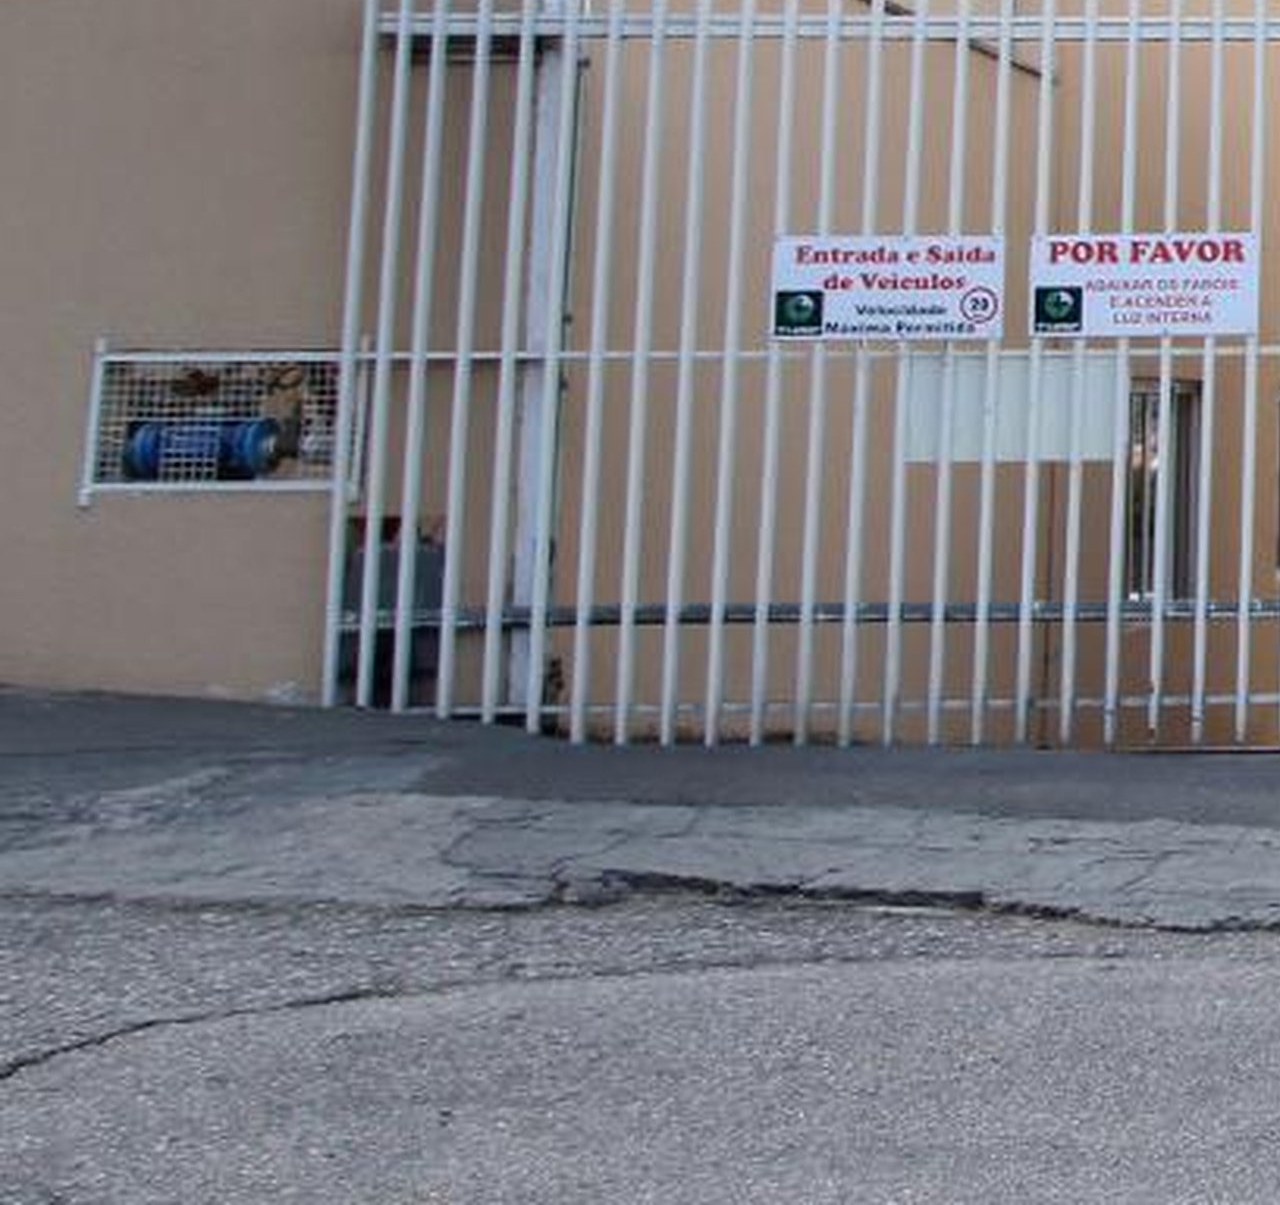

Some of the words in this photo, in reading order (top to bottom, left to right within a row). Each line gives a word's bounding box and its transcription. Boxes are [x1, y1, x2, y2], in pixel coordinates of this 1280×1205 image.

[796, 246, 899, 264] Entrada
[906, 249, 920, 263] e
[1050, 240, 1118, 263] POR
[1129, 240, 1245, 263] FAVOR
[823, 274, 853, 290] de
[1113, 312, 1141, 324] LUZ
